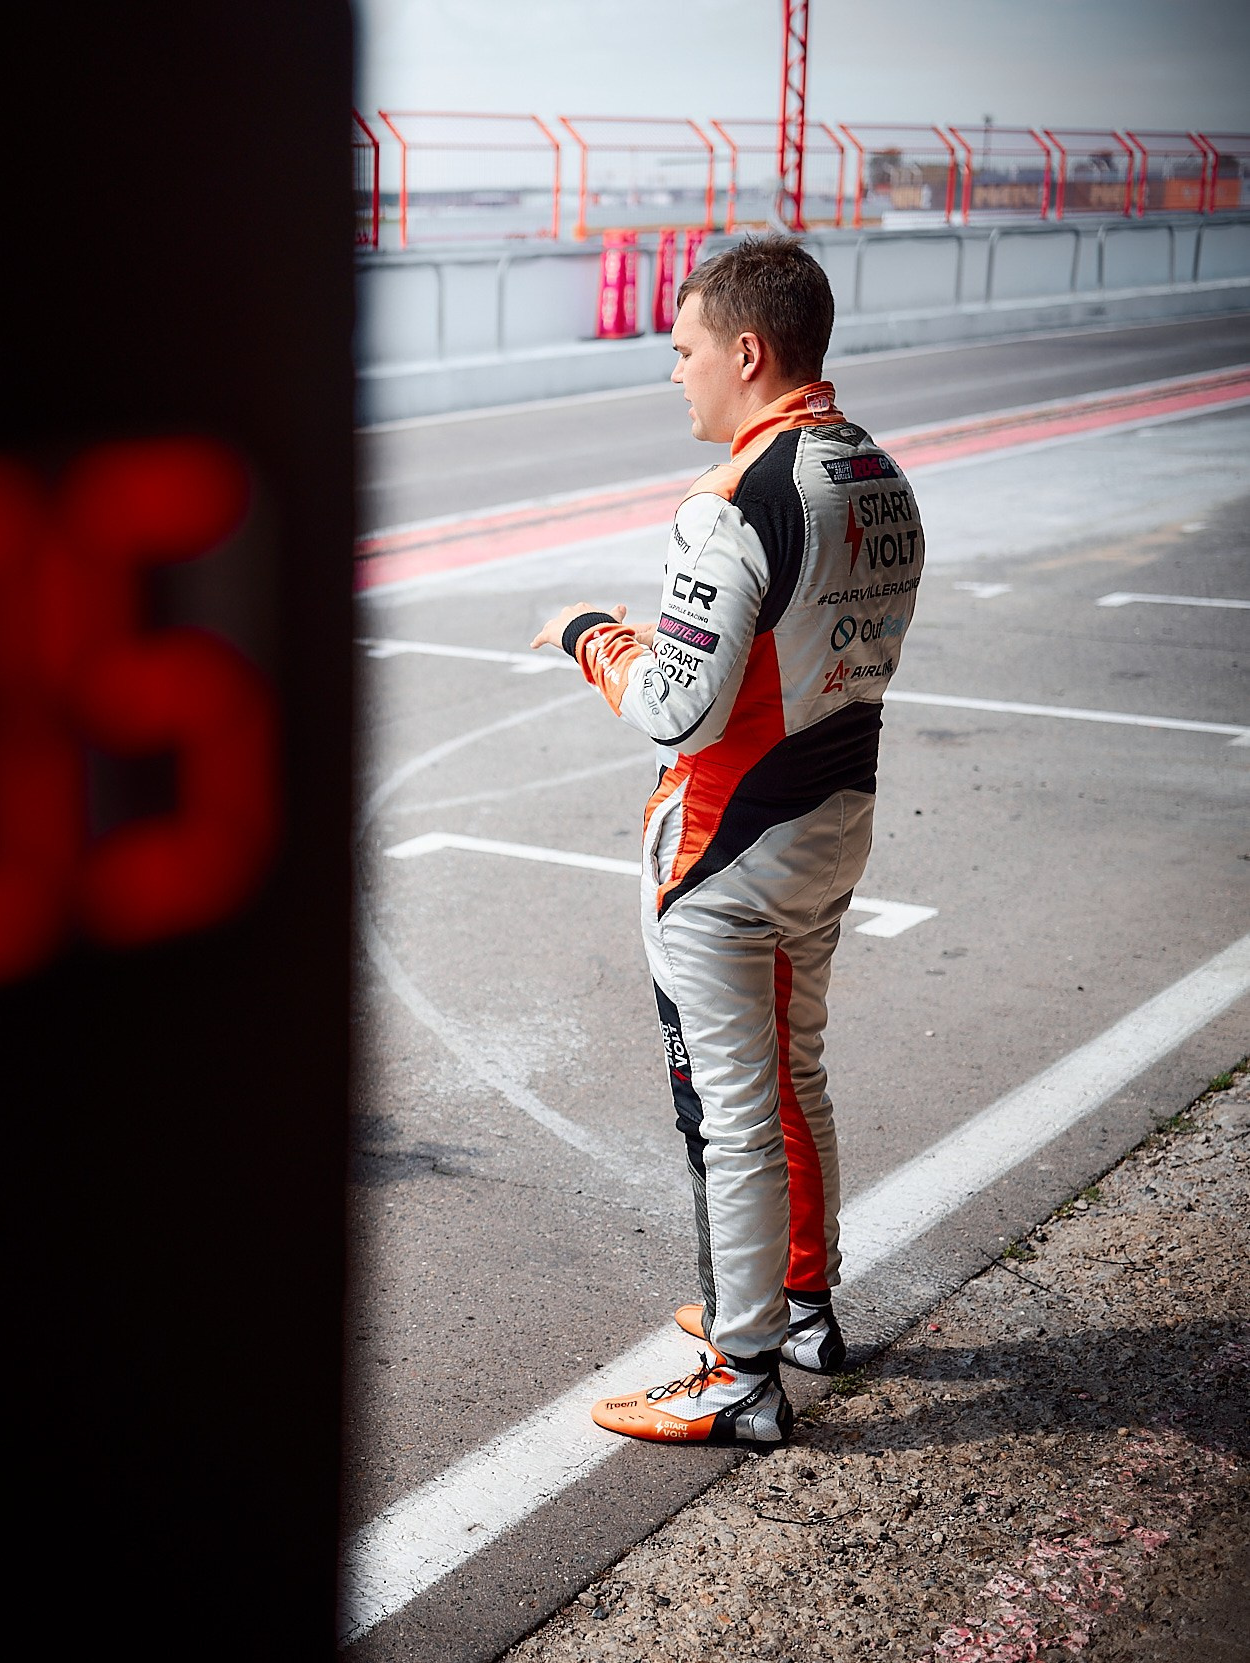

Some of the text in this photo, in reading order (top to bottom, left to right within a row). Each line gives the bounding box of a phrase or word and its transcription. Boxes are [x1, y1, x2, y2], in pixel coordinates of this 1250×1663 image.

[852, 457, 882, 478] RDS
[859, 490, 912, 527] START
[674, 523, 691, 554] reem
[865, 530, 917, 570] VOLT
[672, 573, 718, 611] CR
[687, 610, 709, 624] RACING
[660, 643, 704, 671] START
[668, 1023, 687, 1067] VOLT
[663, 1421, 689, 1431] START
[663, 1429, 688, 1438] VOLT
